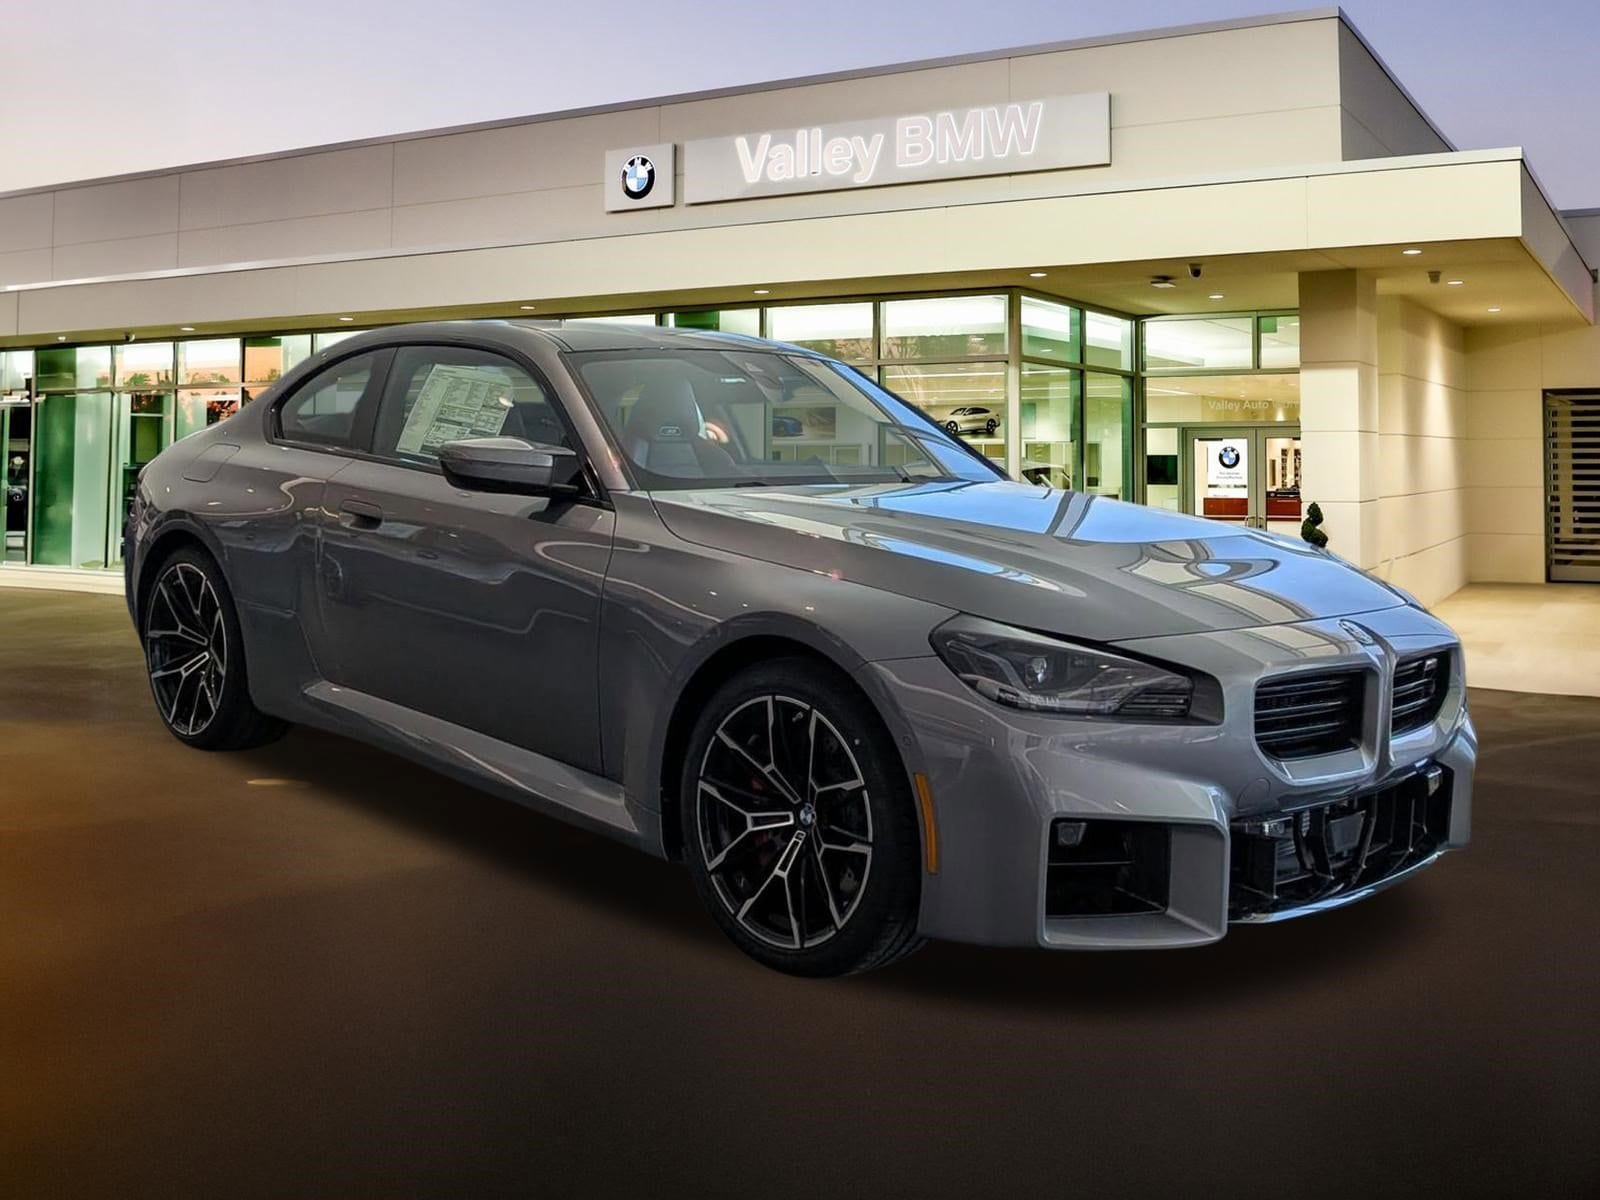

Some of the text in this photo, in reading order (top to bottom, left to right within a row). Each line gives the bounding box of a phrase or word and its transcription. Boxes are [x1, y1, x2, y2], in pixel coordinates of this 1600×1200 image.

[735, 102, 1043, 183] Valley BMW
[1208, 399, 1240, 412] Valley
[1243, 400, 1269, 409] Auto
